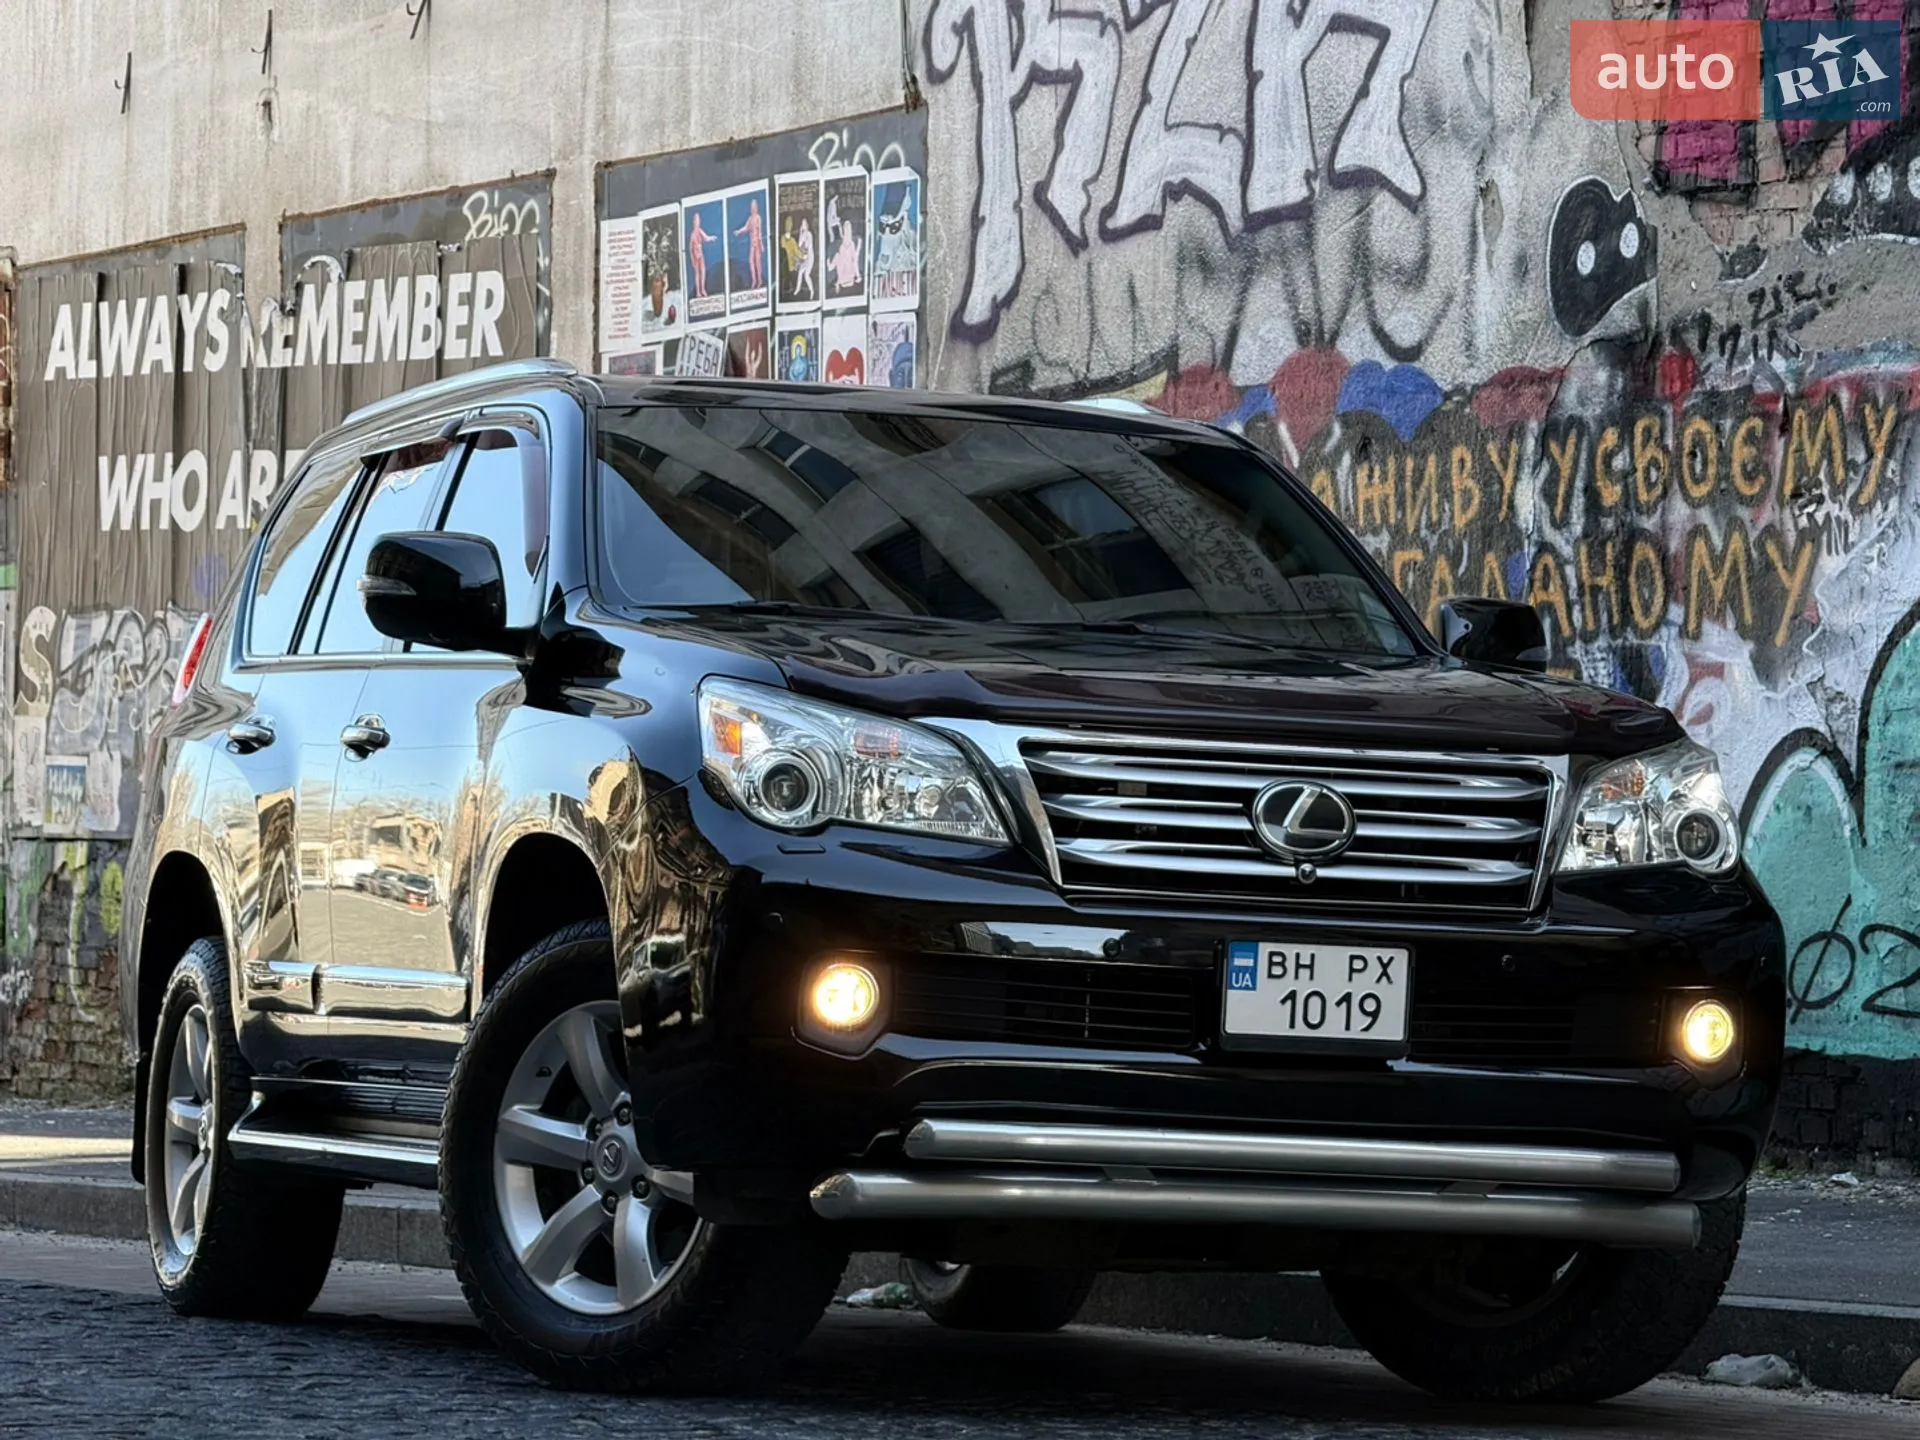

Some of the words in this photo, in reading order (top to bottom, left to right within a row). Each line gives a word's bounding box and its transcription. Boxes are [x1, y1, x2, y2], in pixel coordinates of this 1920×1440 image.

[44, 289, 231, 381] ALWAYS
[98, 449, 208, 531] WHO
[1231, 972, 1253, 988] UA
[1267, 950, 1315, 981] BH
[1348, 954, 1395, 984] PX
[1279, 989, 1382, 1032] 1019
